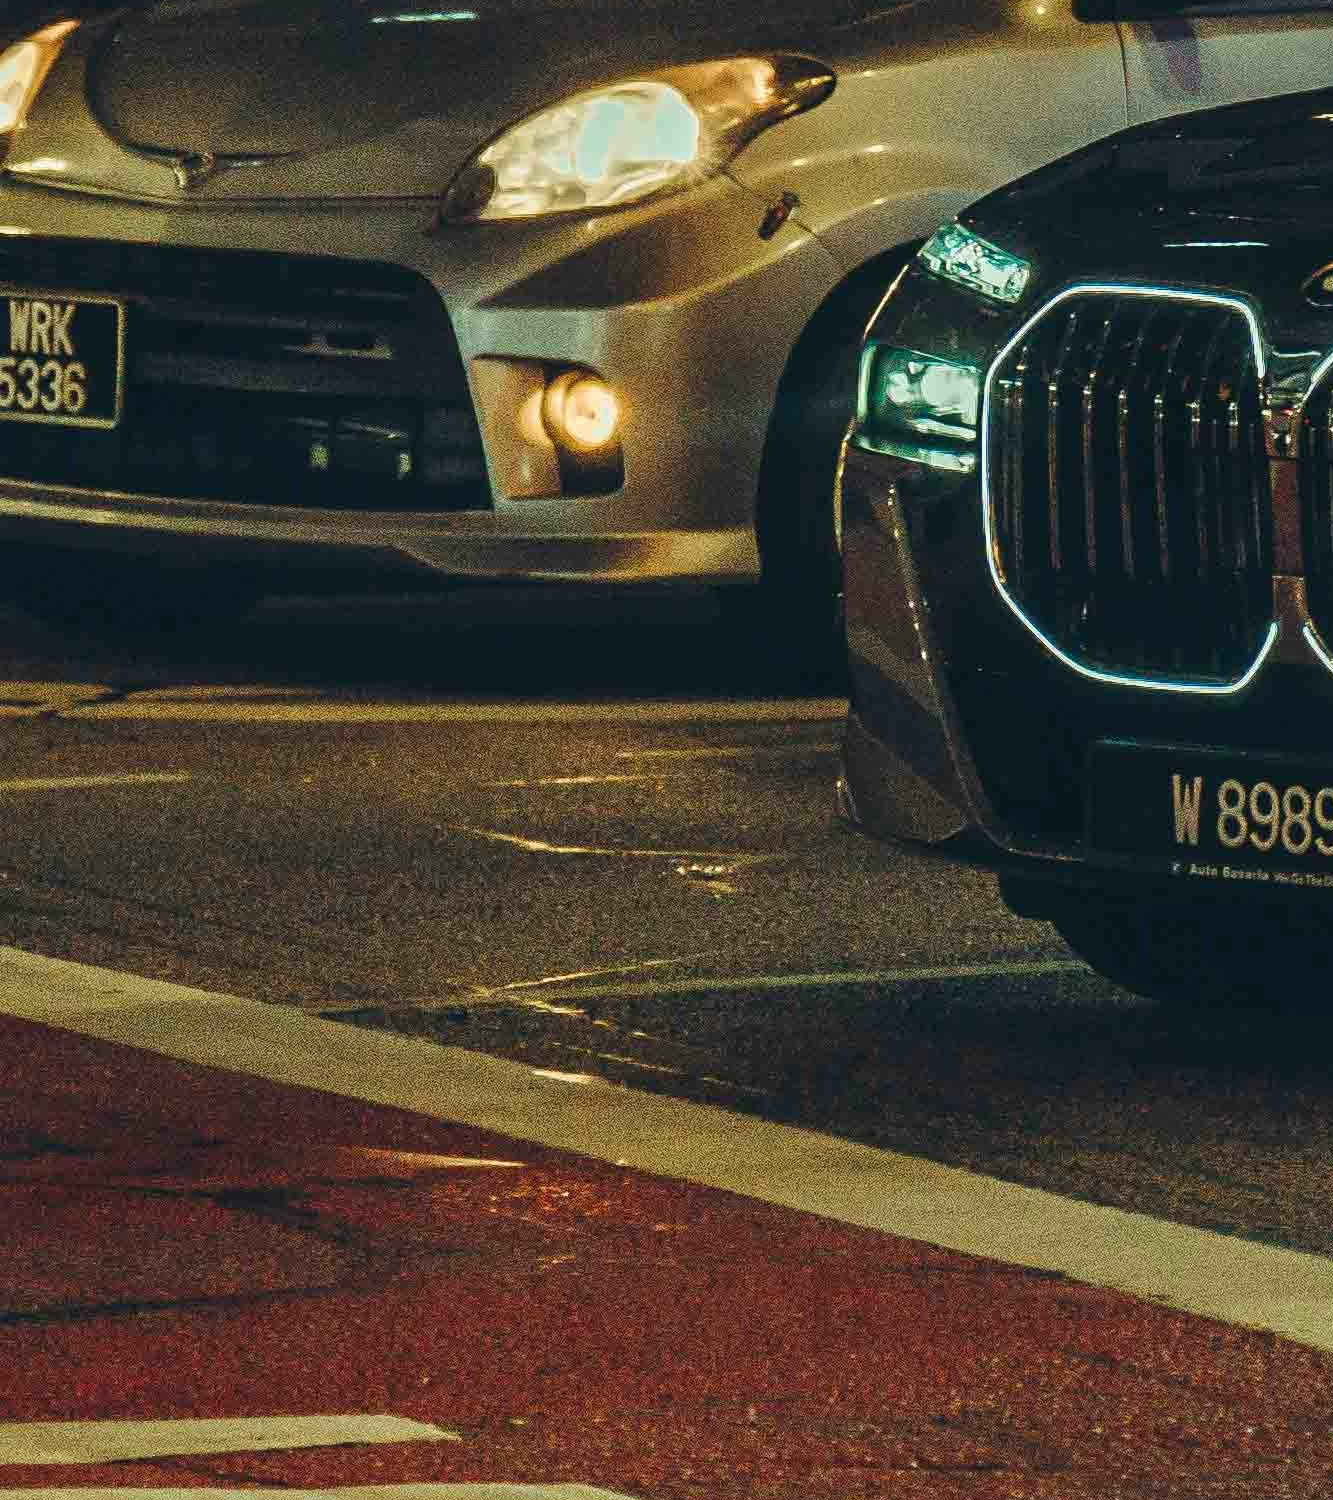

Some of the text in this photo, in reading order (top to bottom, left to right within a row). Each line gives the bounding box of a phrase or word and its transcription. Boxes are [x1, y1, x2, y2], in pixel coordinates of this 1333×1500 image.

[9, 300, 77, 355] WRK
[0, 357, 88, 412] 5336
[1171, 773, 1203, 847] W
